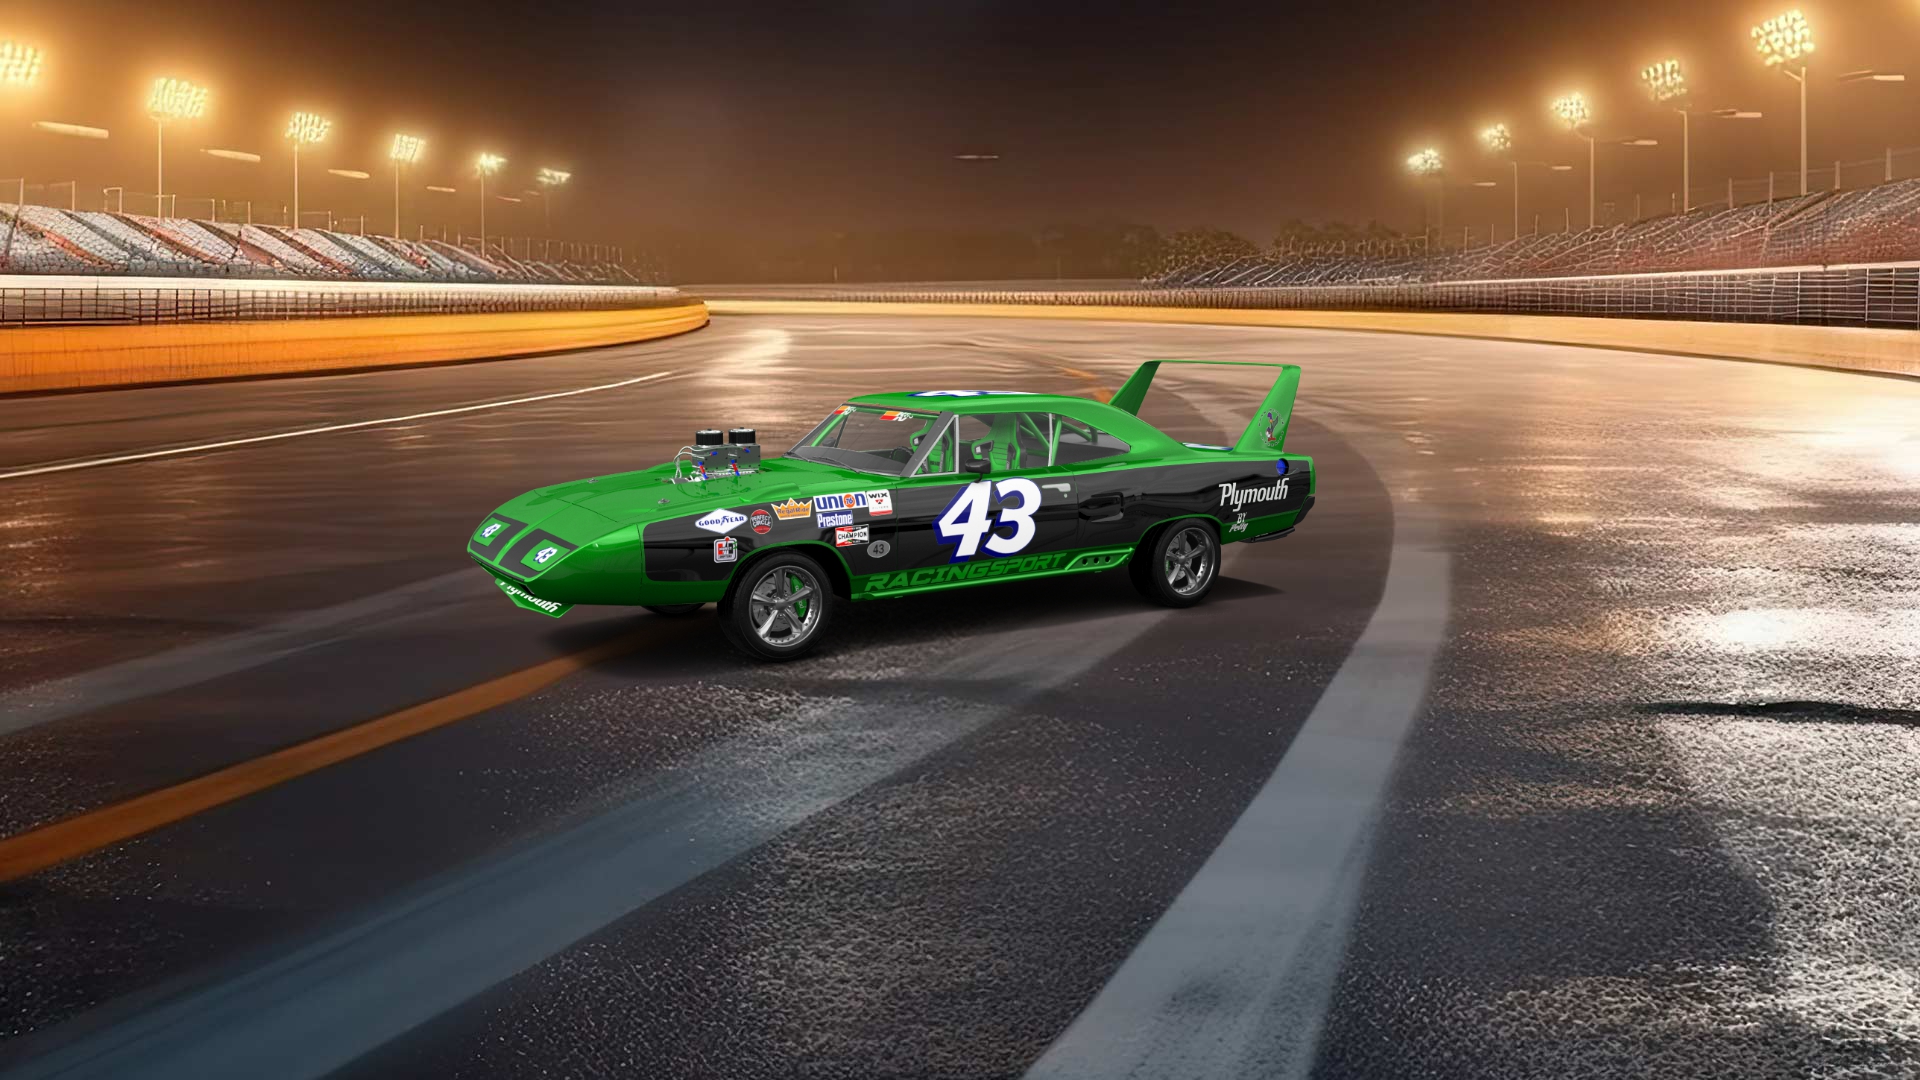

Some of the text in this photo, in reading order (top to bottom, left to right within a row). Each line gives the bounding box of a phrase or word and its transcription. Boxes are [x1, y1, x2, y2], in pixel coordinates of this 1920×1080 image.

[1219, 478, 1290, 512] Plymouth
[817, 513, 853, 528] Prestone
[932, 477, 1042, 563] 43
[838, 531, 867, 540] CHAMPION
[533, 546, 558, 564] 43
[873, 544, 885, 555] 43
[864, 553, 1068, 591] RACINGSPORT
[499, 581, 562, 613] ymouth
